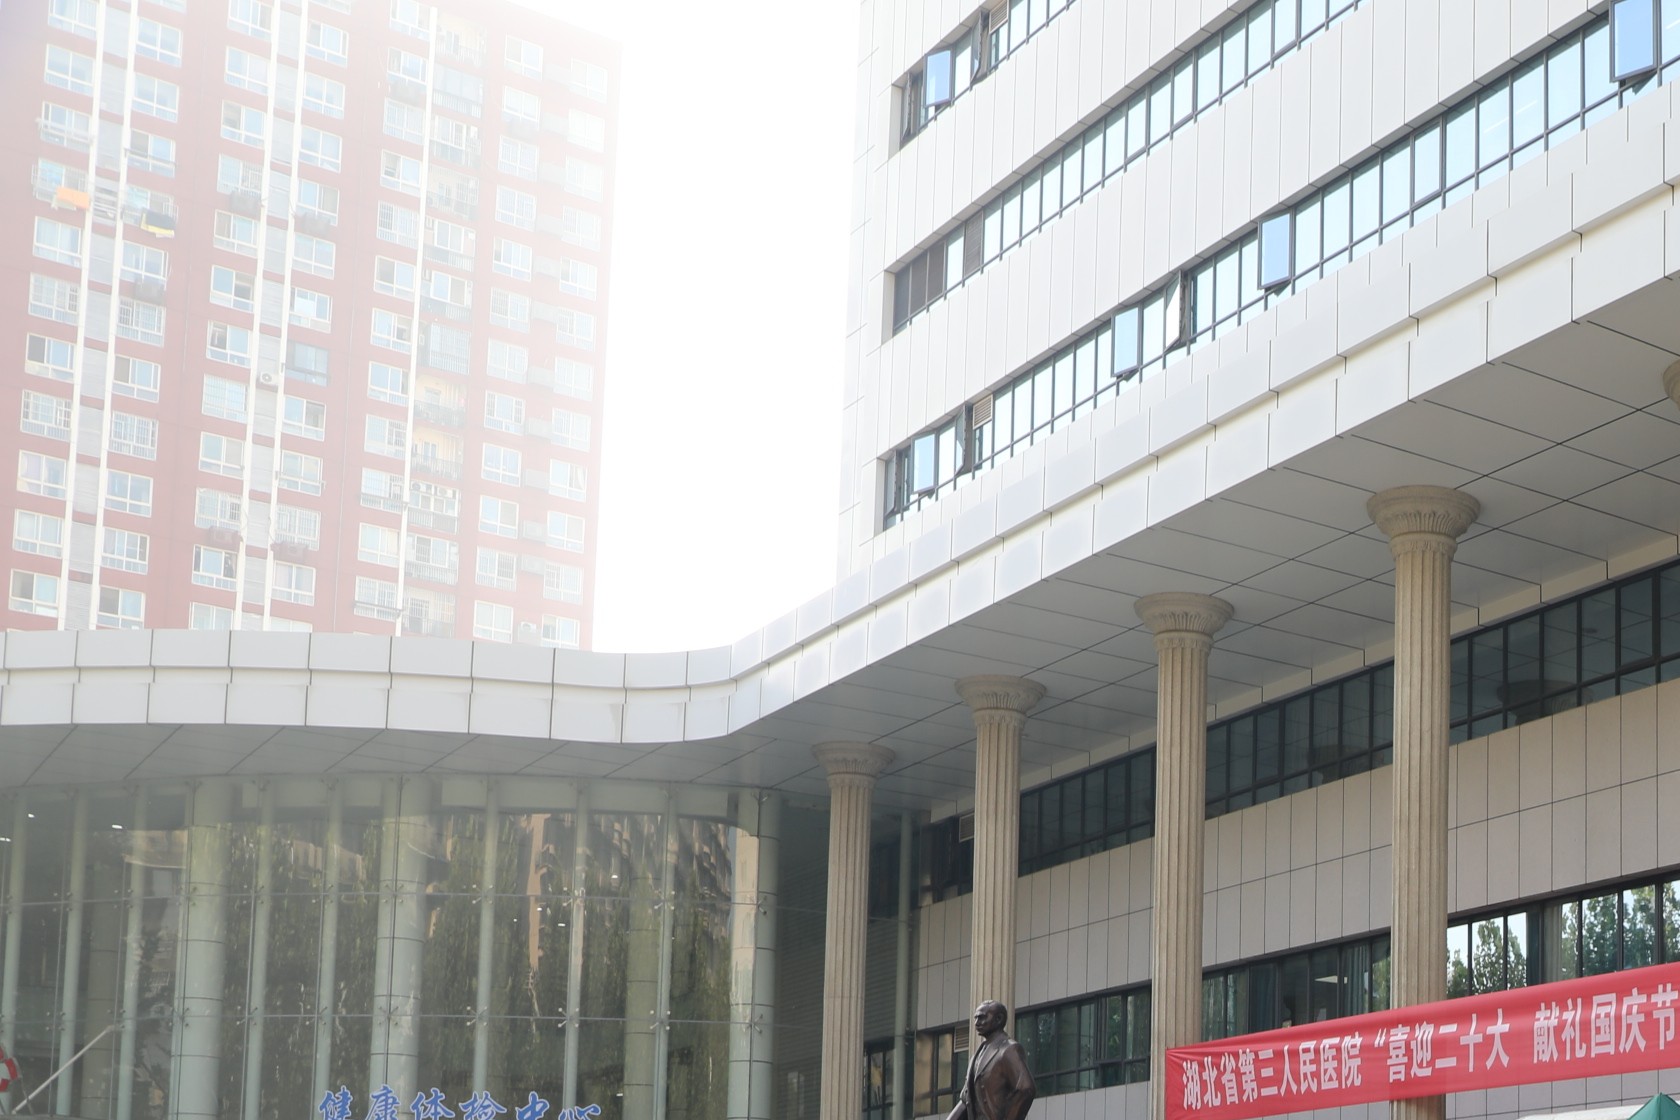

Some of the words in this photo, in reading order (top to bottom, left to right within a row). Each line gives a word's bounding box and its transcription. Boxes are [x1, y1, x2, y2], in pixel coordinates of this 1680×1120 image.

[1182, 1031, 1363, 1111] 湖北省第三人民医院
